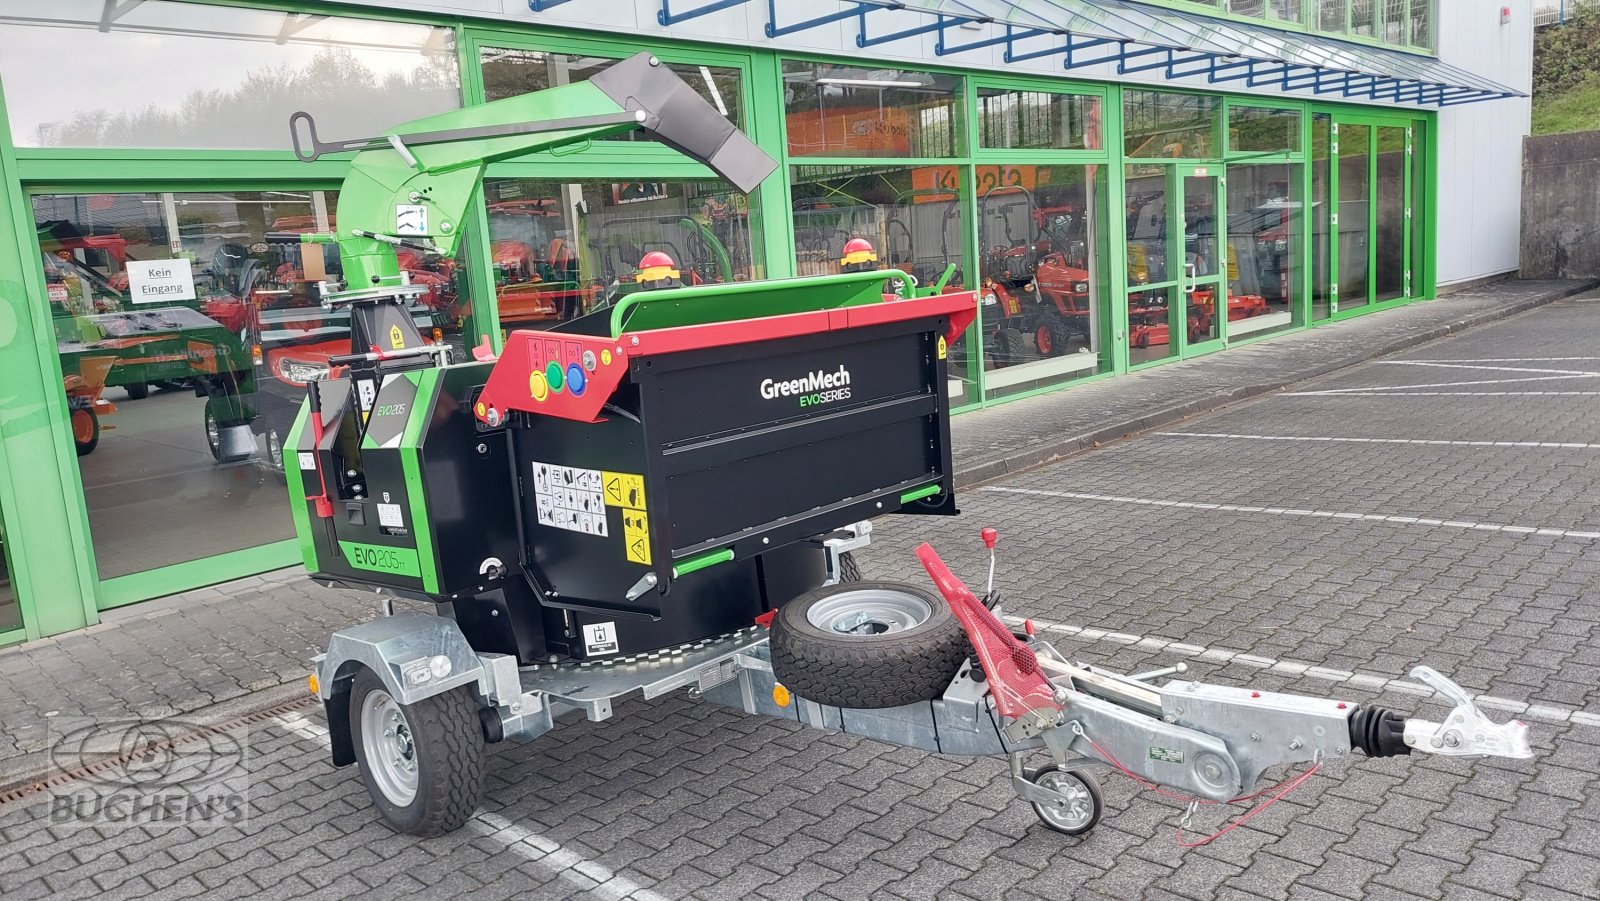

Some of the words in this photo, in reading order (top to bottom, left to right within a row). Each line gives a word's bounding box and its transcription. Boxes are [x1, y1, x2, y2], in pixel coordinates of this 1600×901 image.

[148, 268, 172, 278] Kein
[142, 284, 183, 295] Eingang
[760, 364, 850, 399] GreenMech
[800, 387, 851, 407] EVOSERIES
